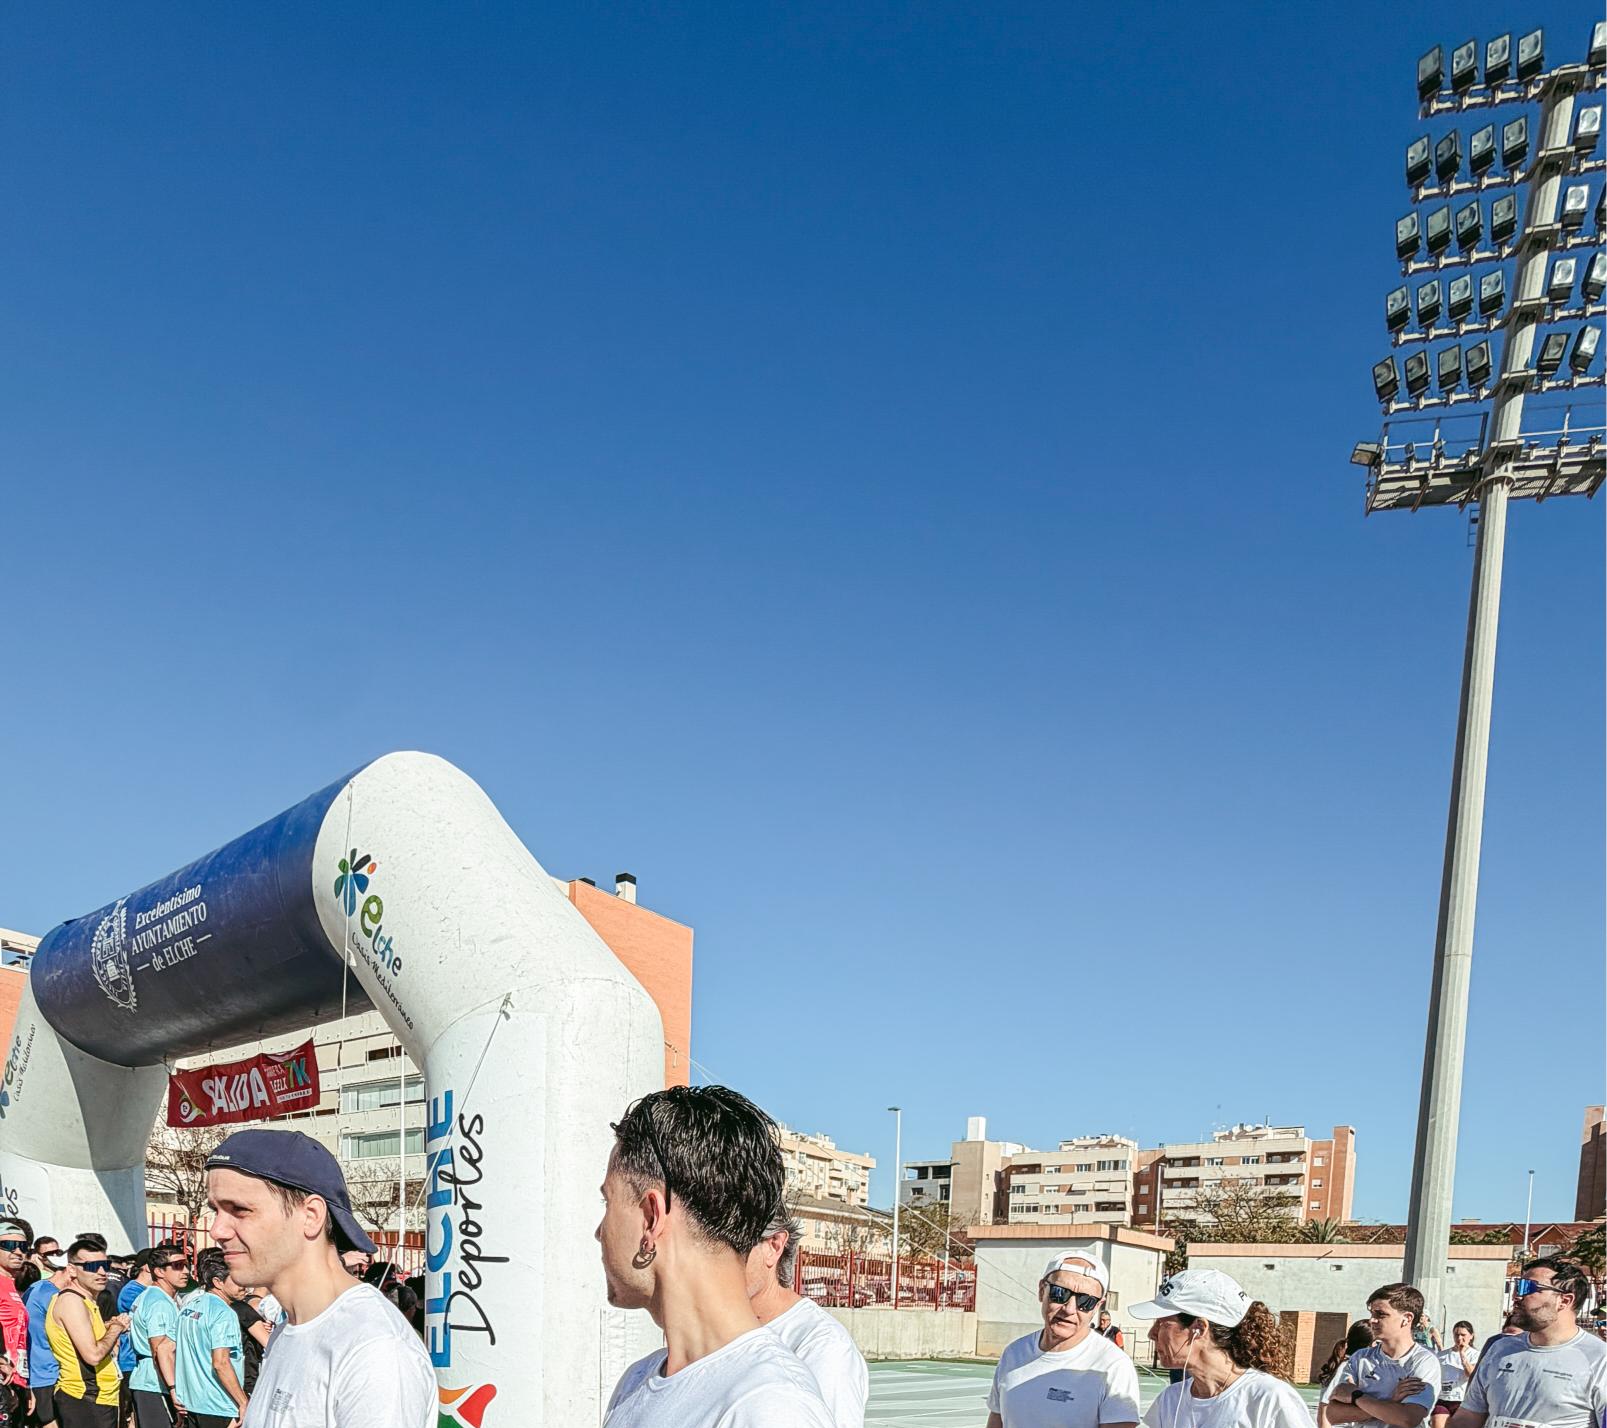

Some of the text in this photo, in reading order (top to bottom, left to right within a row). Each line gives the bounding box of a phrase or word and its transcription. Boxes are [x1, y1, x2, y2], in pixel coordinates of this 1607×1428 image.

[131, 902, 207, 956] AYUNTAMIENTO
[135, 884, 201, 930] Excelentísimo
[152, 936, 198, 972] de ELCHE
[201, 1067, 271, 1116] SALIDA
[426, 1089, 453, 1368] ELCHE
[438, 1112, 510, 1347] Deportes
